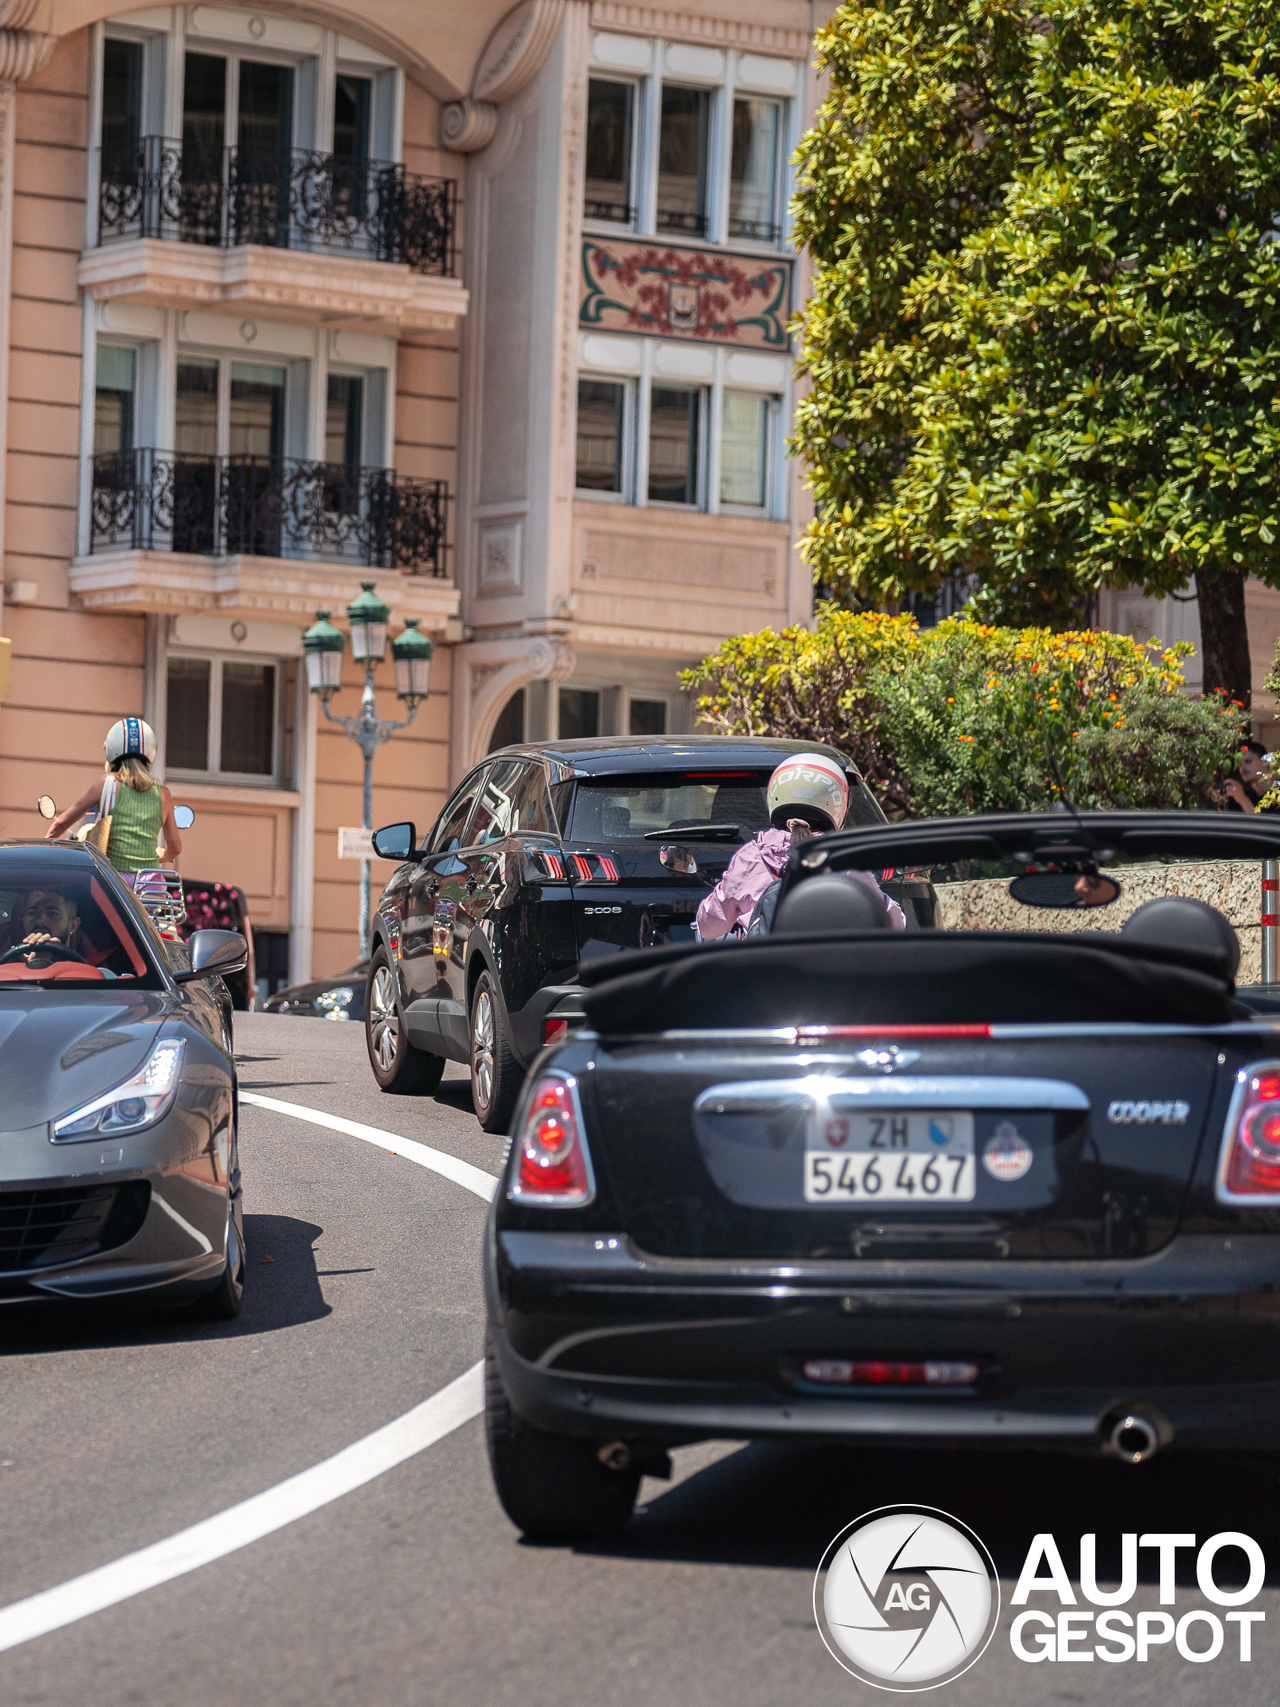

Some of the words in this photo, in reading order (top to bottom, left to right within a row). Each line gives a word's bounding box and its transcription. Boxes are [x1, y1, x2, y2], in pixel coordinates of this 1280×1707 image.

[584, 906, 622, 915] 3008
[1107, 1100, 1190, 1124] COOPER
[869, 1117, 908, 1148] ZH
[813, 1156, 883, 1195] 546
[895, 1156, 967, 1195] 467
